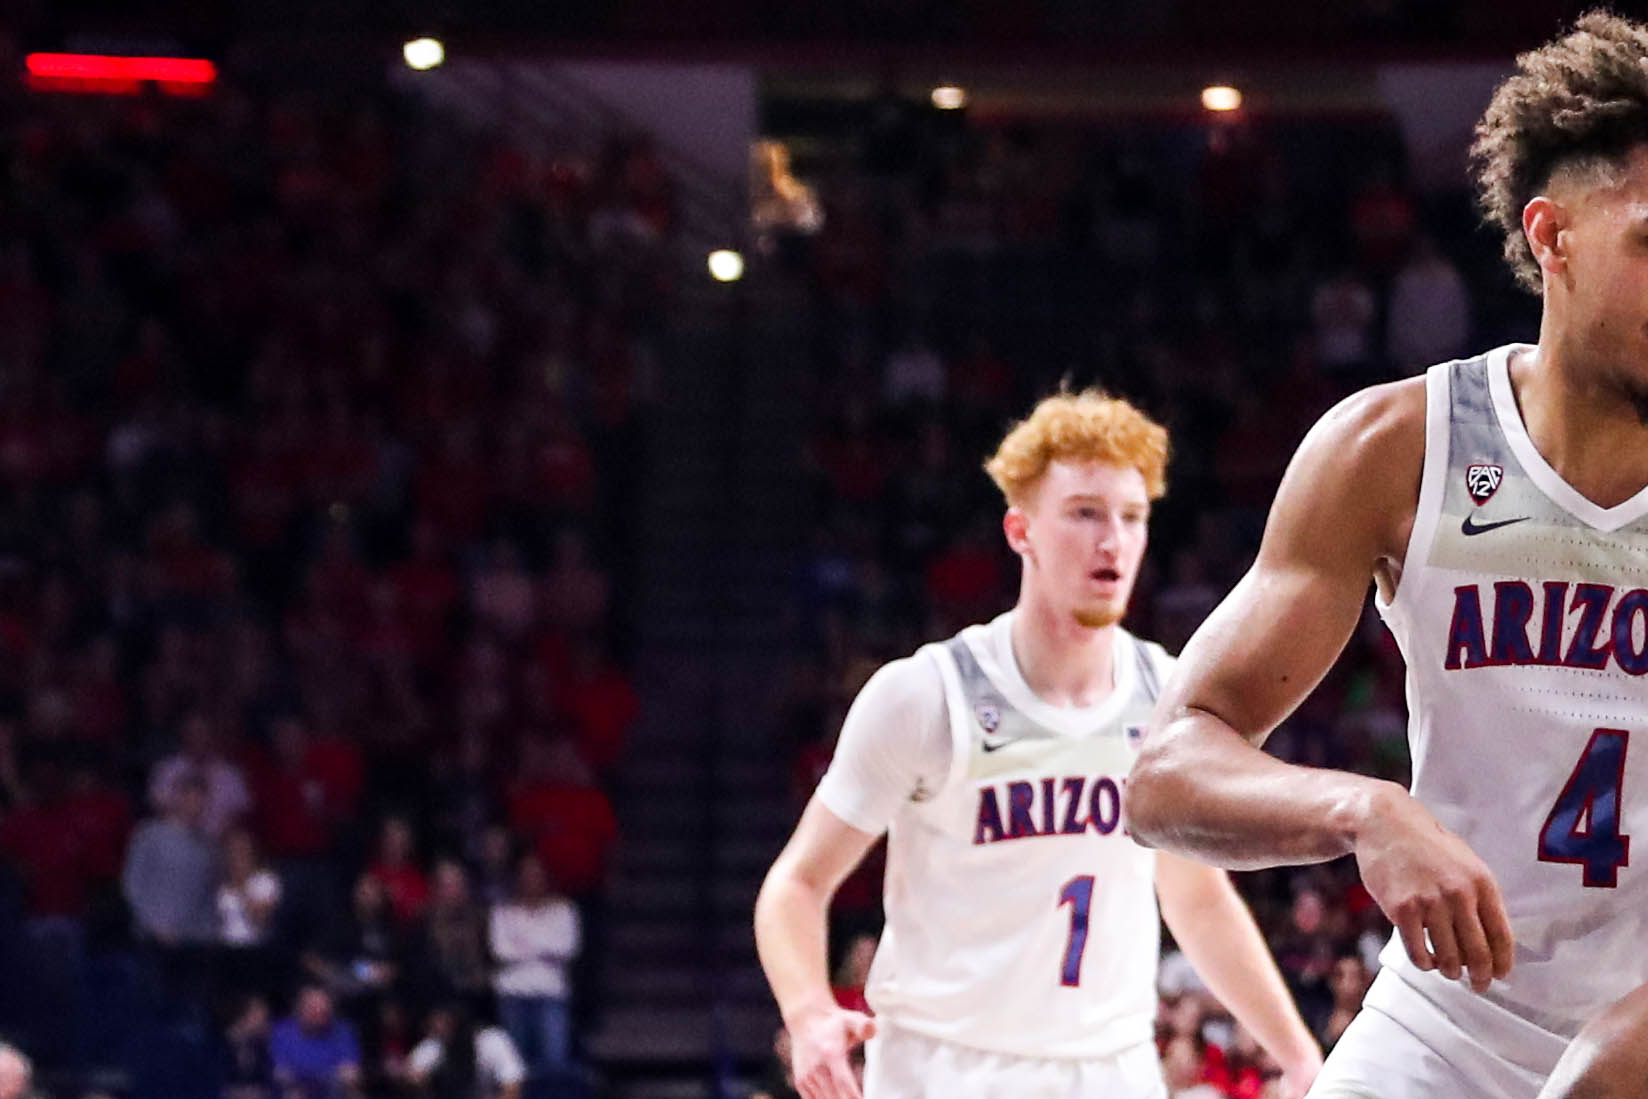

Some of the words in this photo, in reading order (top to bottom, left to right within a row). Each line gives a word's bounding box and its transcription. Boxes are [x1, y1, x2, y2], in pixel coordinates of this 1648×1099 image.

[972, 776, 1133, 845] ARIZO
[1537, 727, 1630, 888] 4
[1057, 874, 1096, 987] 1
